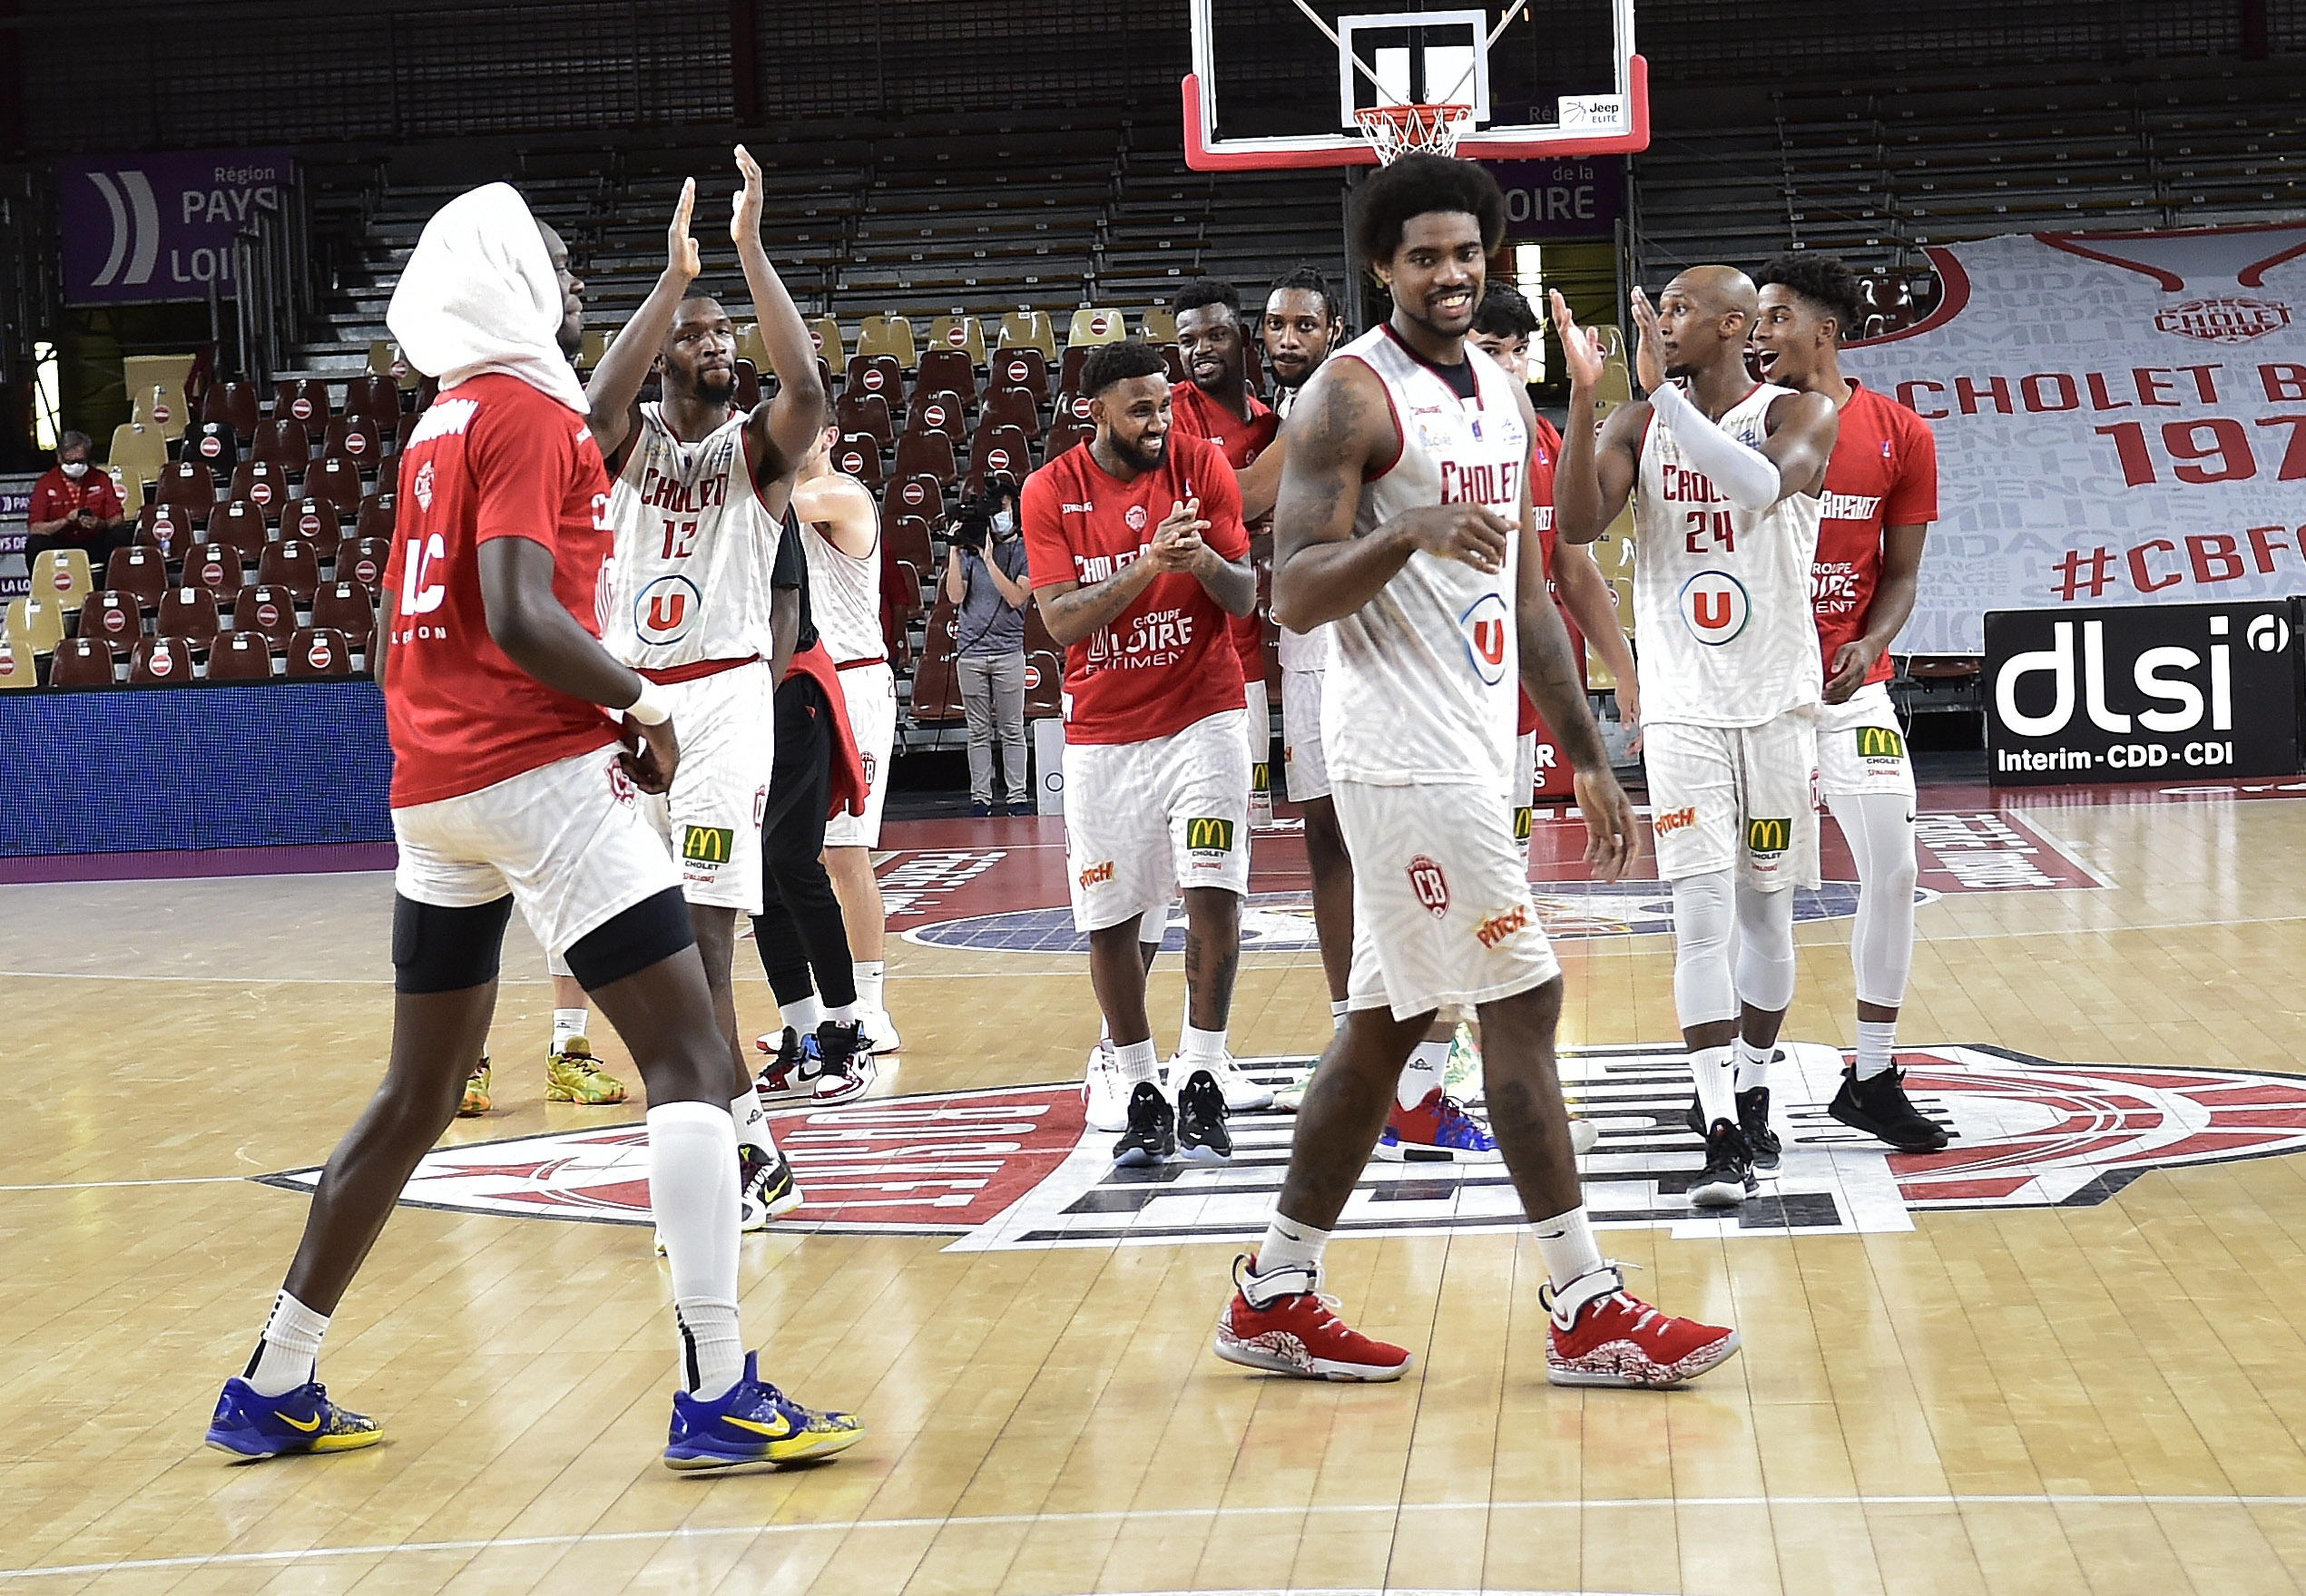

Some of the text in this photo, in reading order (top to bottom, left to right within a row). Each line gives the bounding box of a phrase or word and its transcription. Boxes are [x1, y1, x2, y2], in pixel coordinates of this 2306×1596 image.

[1590, 103, 1619, 113] Jeep
[1592, 115, 1617, 123] ELITE
[215, 166, 275, 184] Région
[1553, 165, 1595, 181] de la
[2154, 302, 2293, 332] CHOLET
[1896, 363, 2223, 420] CHOLET
[661, 519, 698, 560] 12
[1685, 510, 1735, 554] 24
[1693, 592, 1732, 630] U
[1111, 617, 1193, 657] LOIRE
[1995, 614, 2233, 738] dlsi
[684, 860, 721, 871] CHOLET
[1413, 868, 1447, 906] CB
